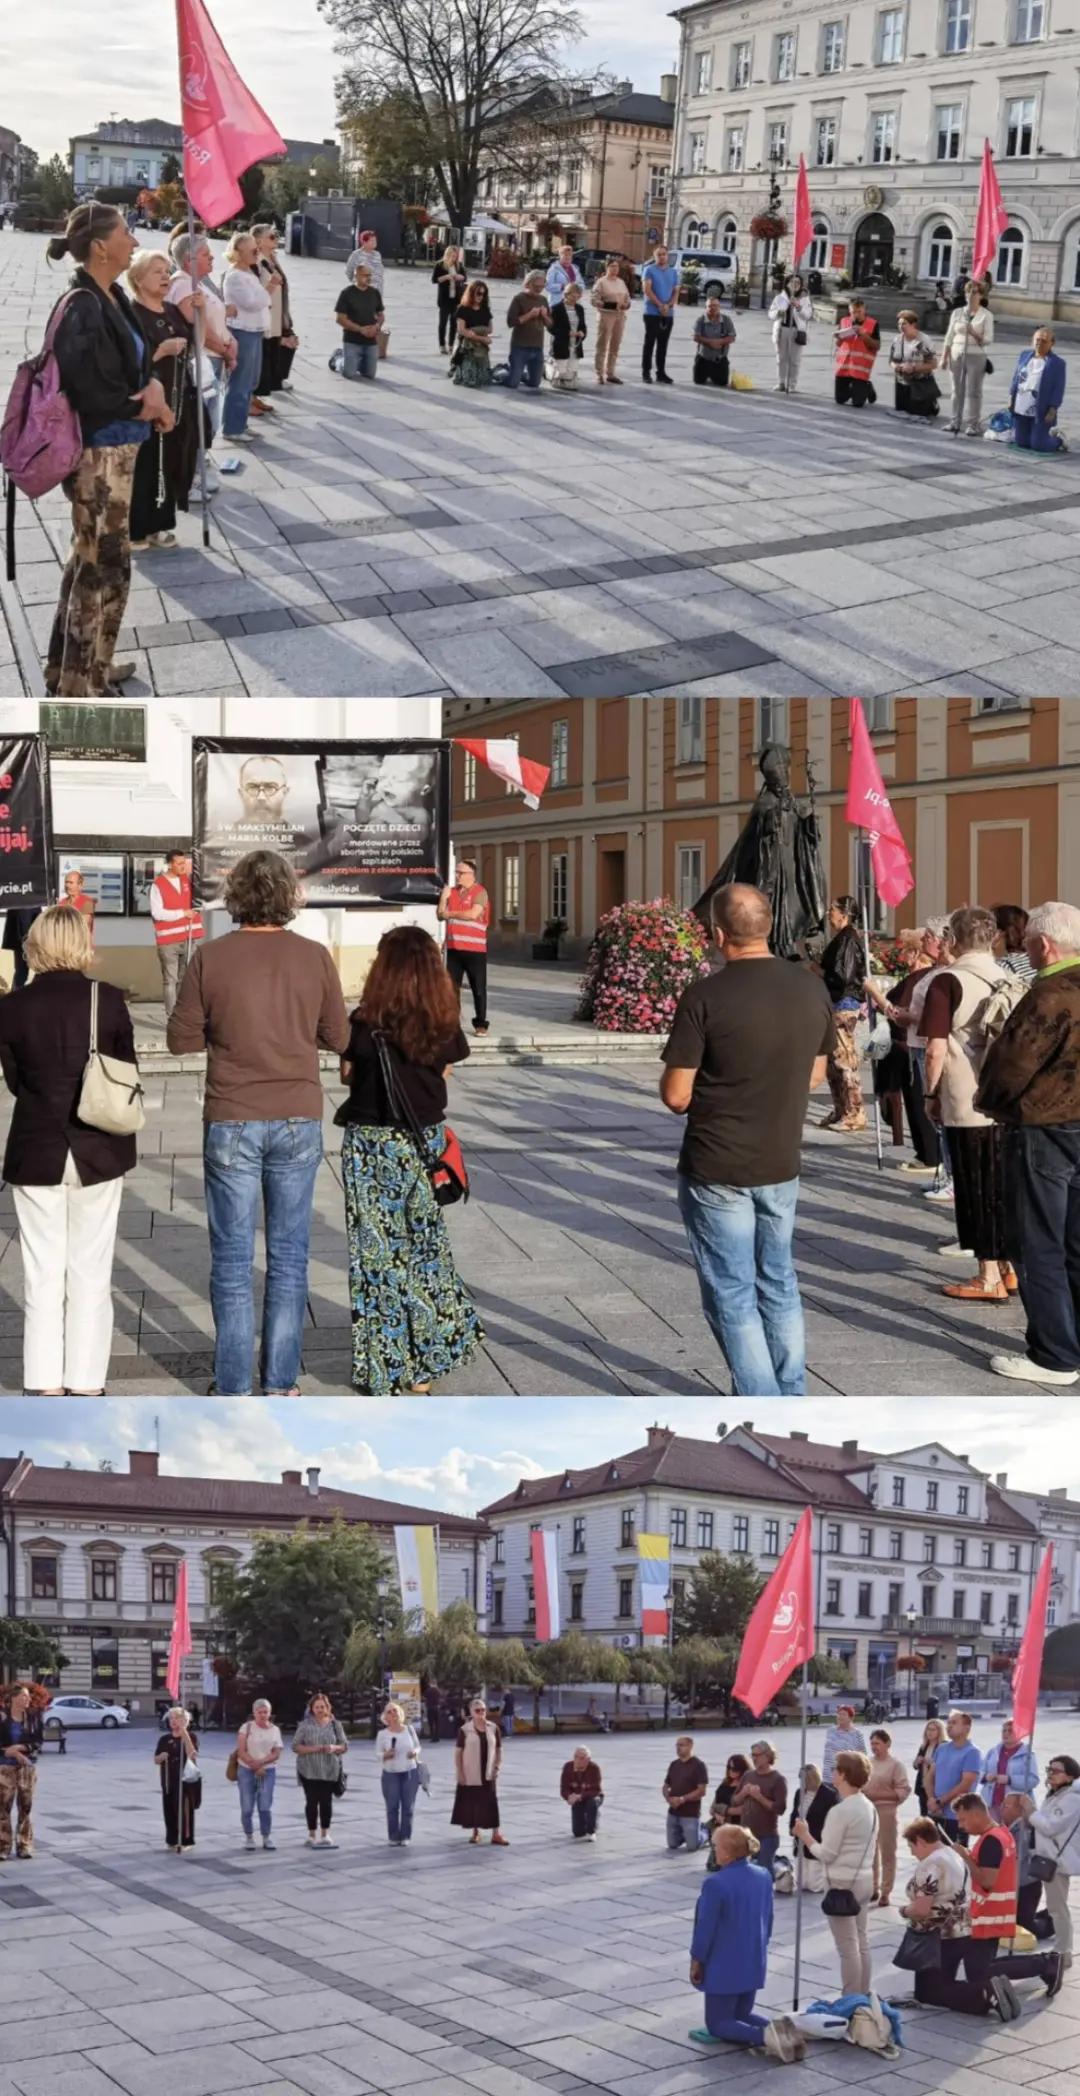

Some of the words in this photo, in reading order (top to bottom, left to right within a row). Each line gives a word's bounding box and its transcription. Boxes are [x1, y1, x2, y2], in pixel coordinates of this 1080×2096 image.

[0, 773, 13, 789] e
[239, 823, 305, 832] MAKSYMILIAN
[343, 823, 387, 834] POCZĘTE
[388, 824, 421, 832] DZIECI
[228, 833, 260, 842] MARIA
[262, 833, 294, 843] KOLBE
[399, 840, 421, 849] przez
[391, 848, 424, 858] polskich
[362, 857, 402, 867] szpitalach
